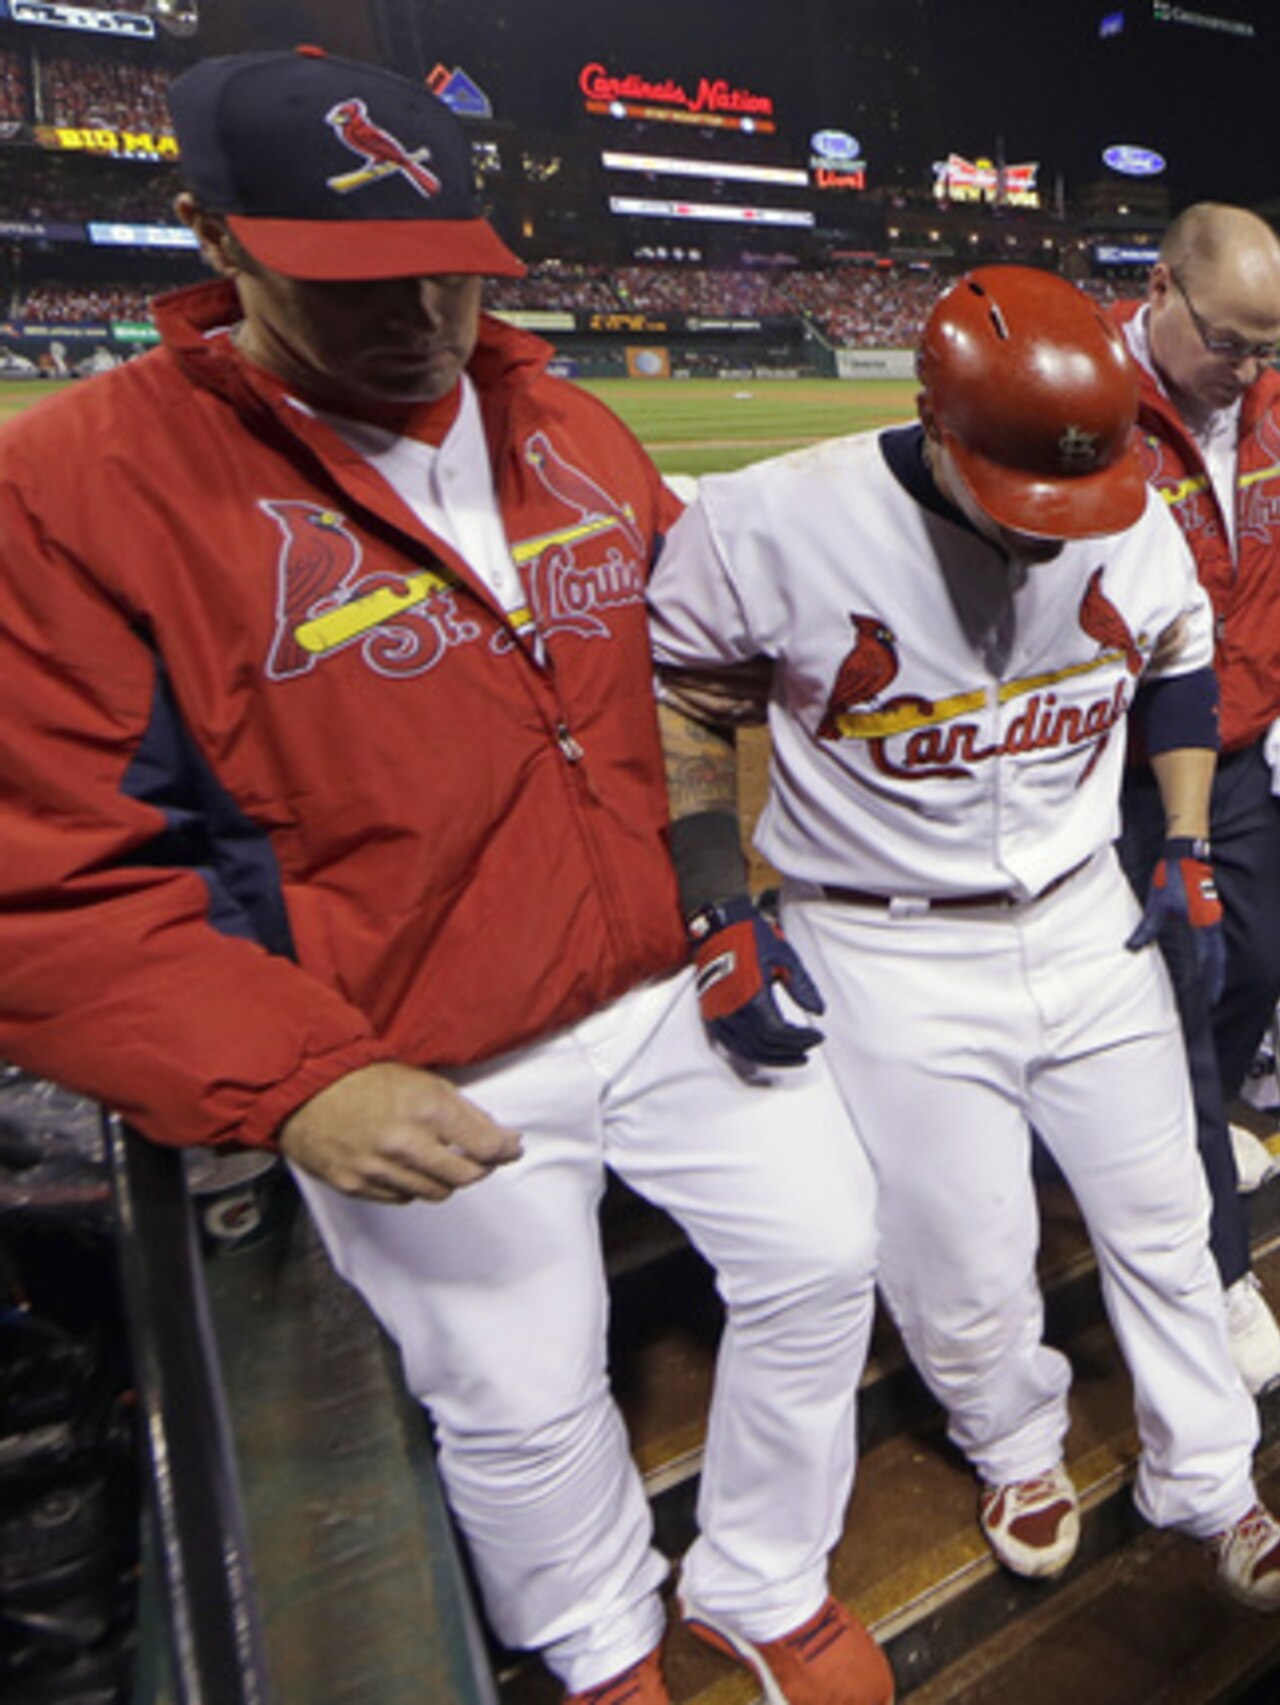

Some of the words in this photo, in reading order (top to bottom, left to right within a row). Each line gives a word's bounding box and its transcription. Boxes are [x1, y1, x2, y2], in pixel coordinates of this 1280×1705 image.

[579, 62, 686, 103] Cardinals
[687, 77, 773, 114] Nation
[56, 128, 118, 150] BIG
[345, 571, 481, 680] St.
[866, 675, 1128, 788] Cardinal
